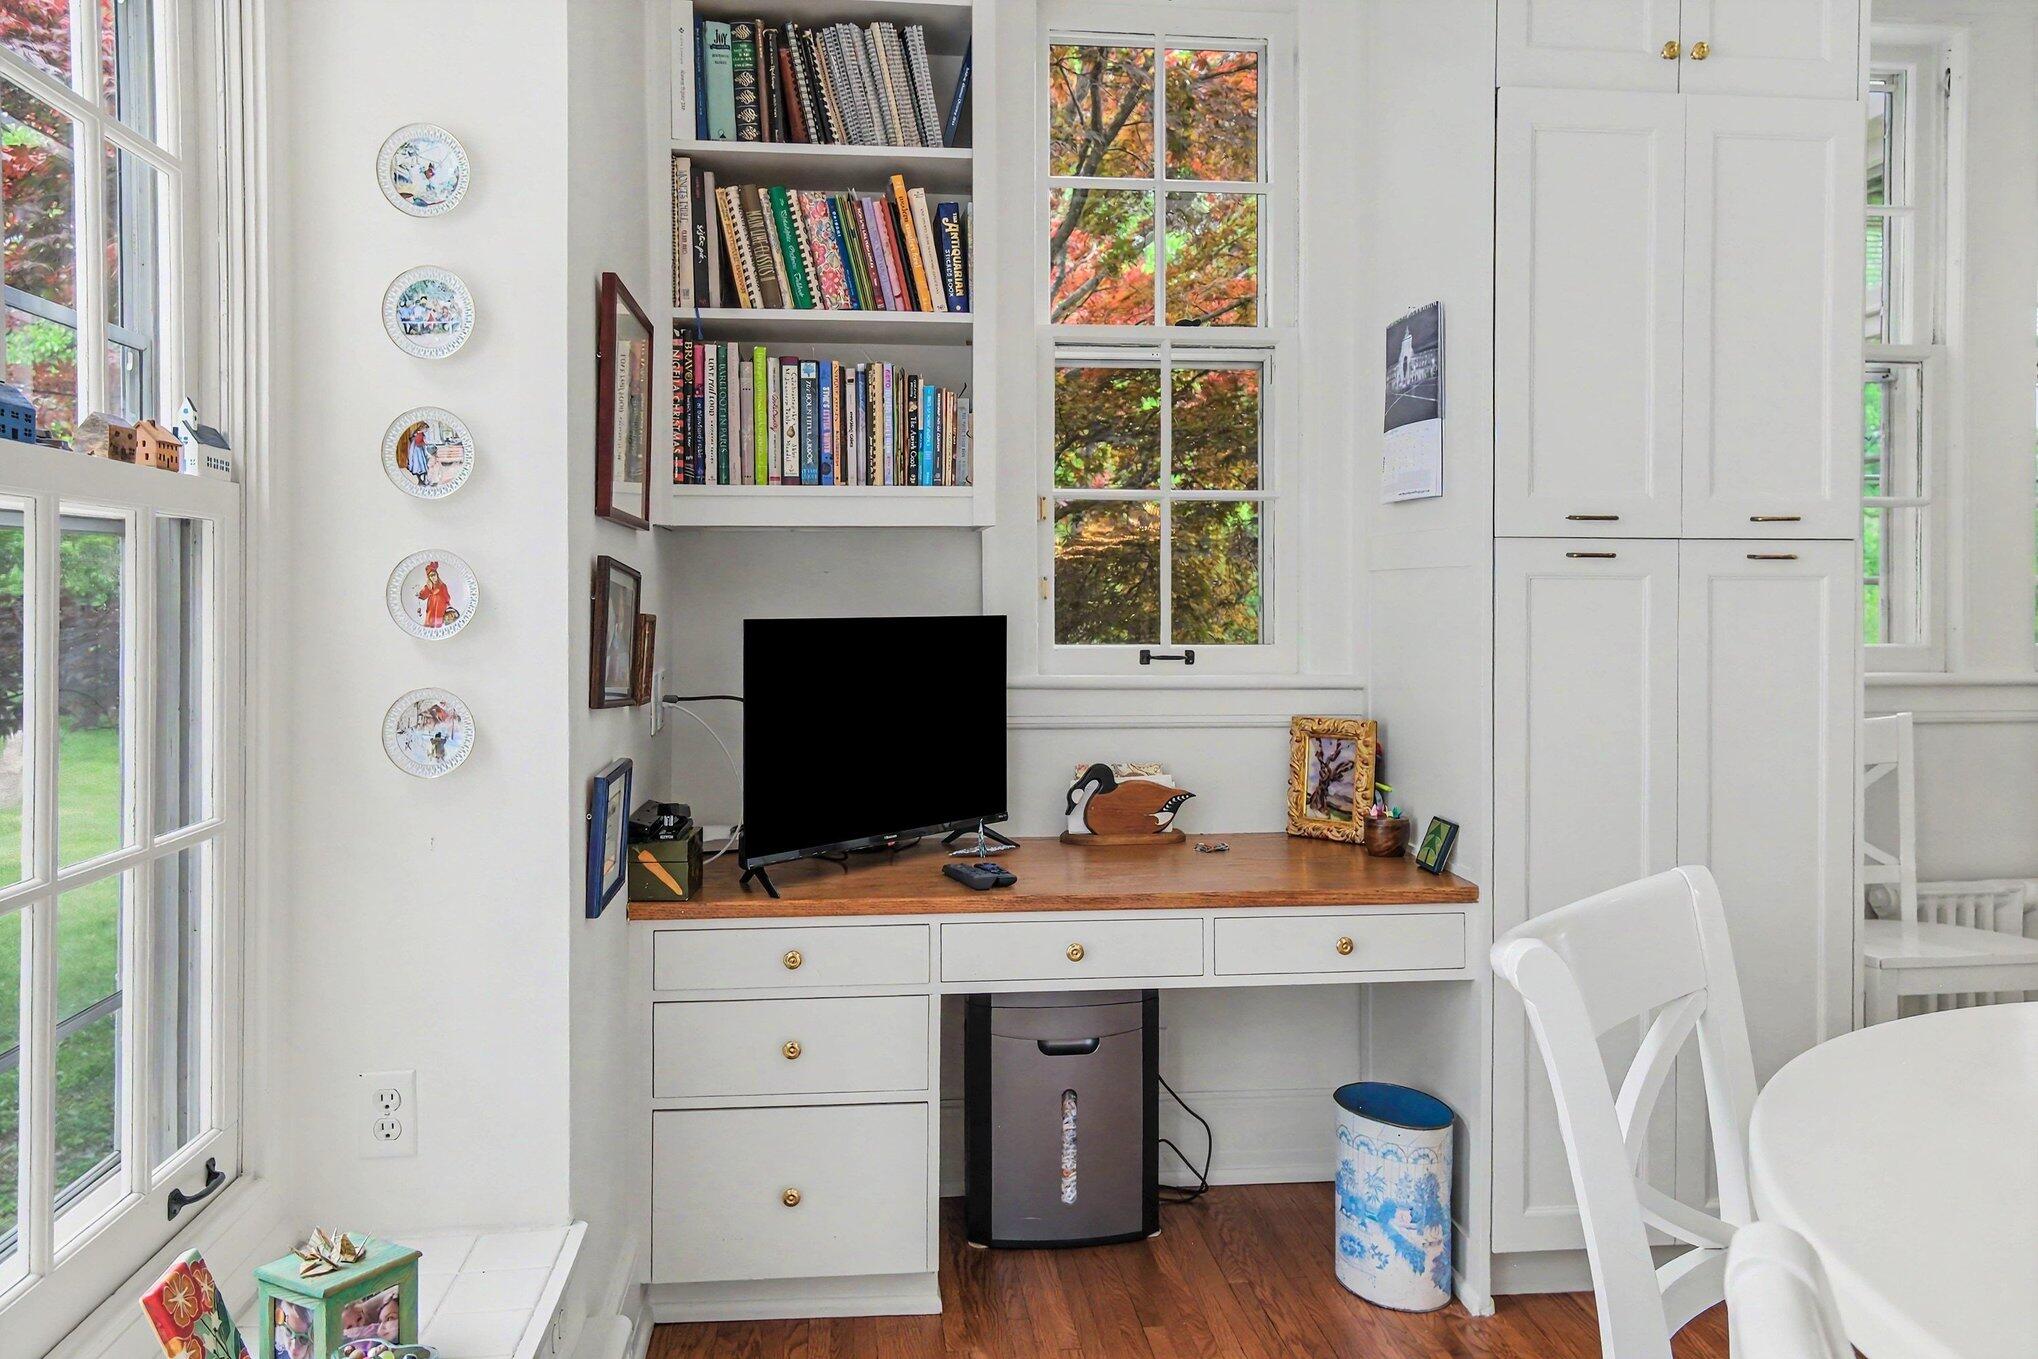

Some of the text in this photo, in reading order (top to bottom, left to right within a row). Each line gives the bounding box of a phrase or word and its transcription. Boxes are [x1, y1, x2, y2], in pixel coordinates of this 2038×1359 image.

[942, 217, 964, 297] ANTIQUARIAN
[685, 341, 693, 385] BRAVO!
[673, 395, 681, 454] CHRISTMAS
